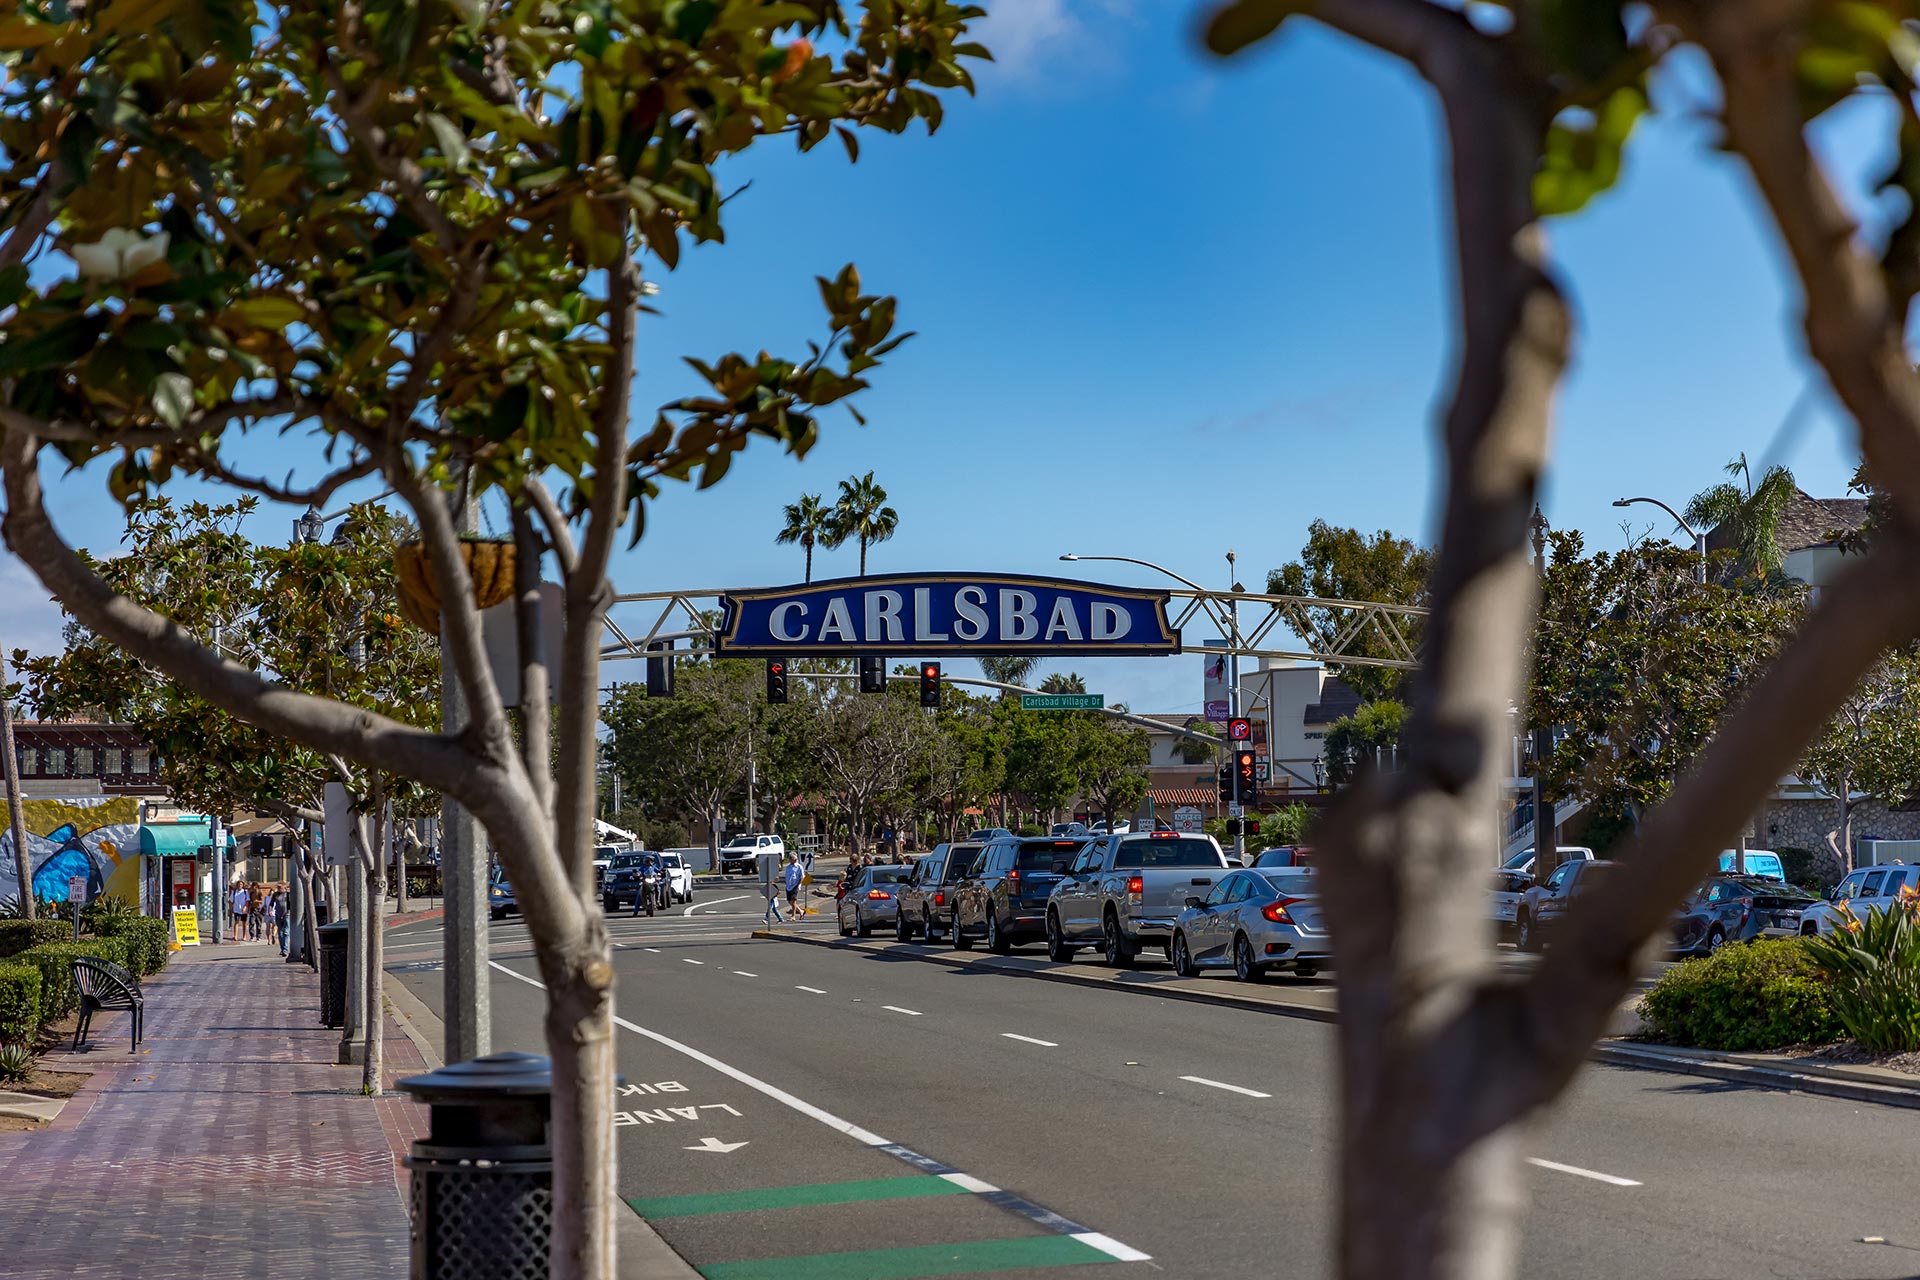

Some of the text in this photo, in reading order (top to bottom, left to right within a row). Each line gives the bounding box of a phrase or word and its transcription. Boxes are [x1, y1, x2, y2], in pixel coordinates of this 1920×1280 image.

[768, 585, 1132, 641] CARLSBAD
[1025, 697, 1100, 707] Carlsbad Village Dr
[1206, 710, 1228, 719] Village
[616, 1080, 690, 1096] BIK
[613, 1103, 743, 1126] LANE
